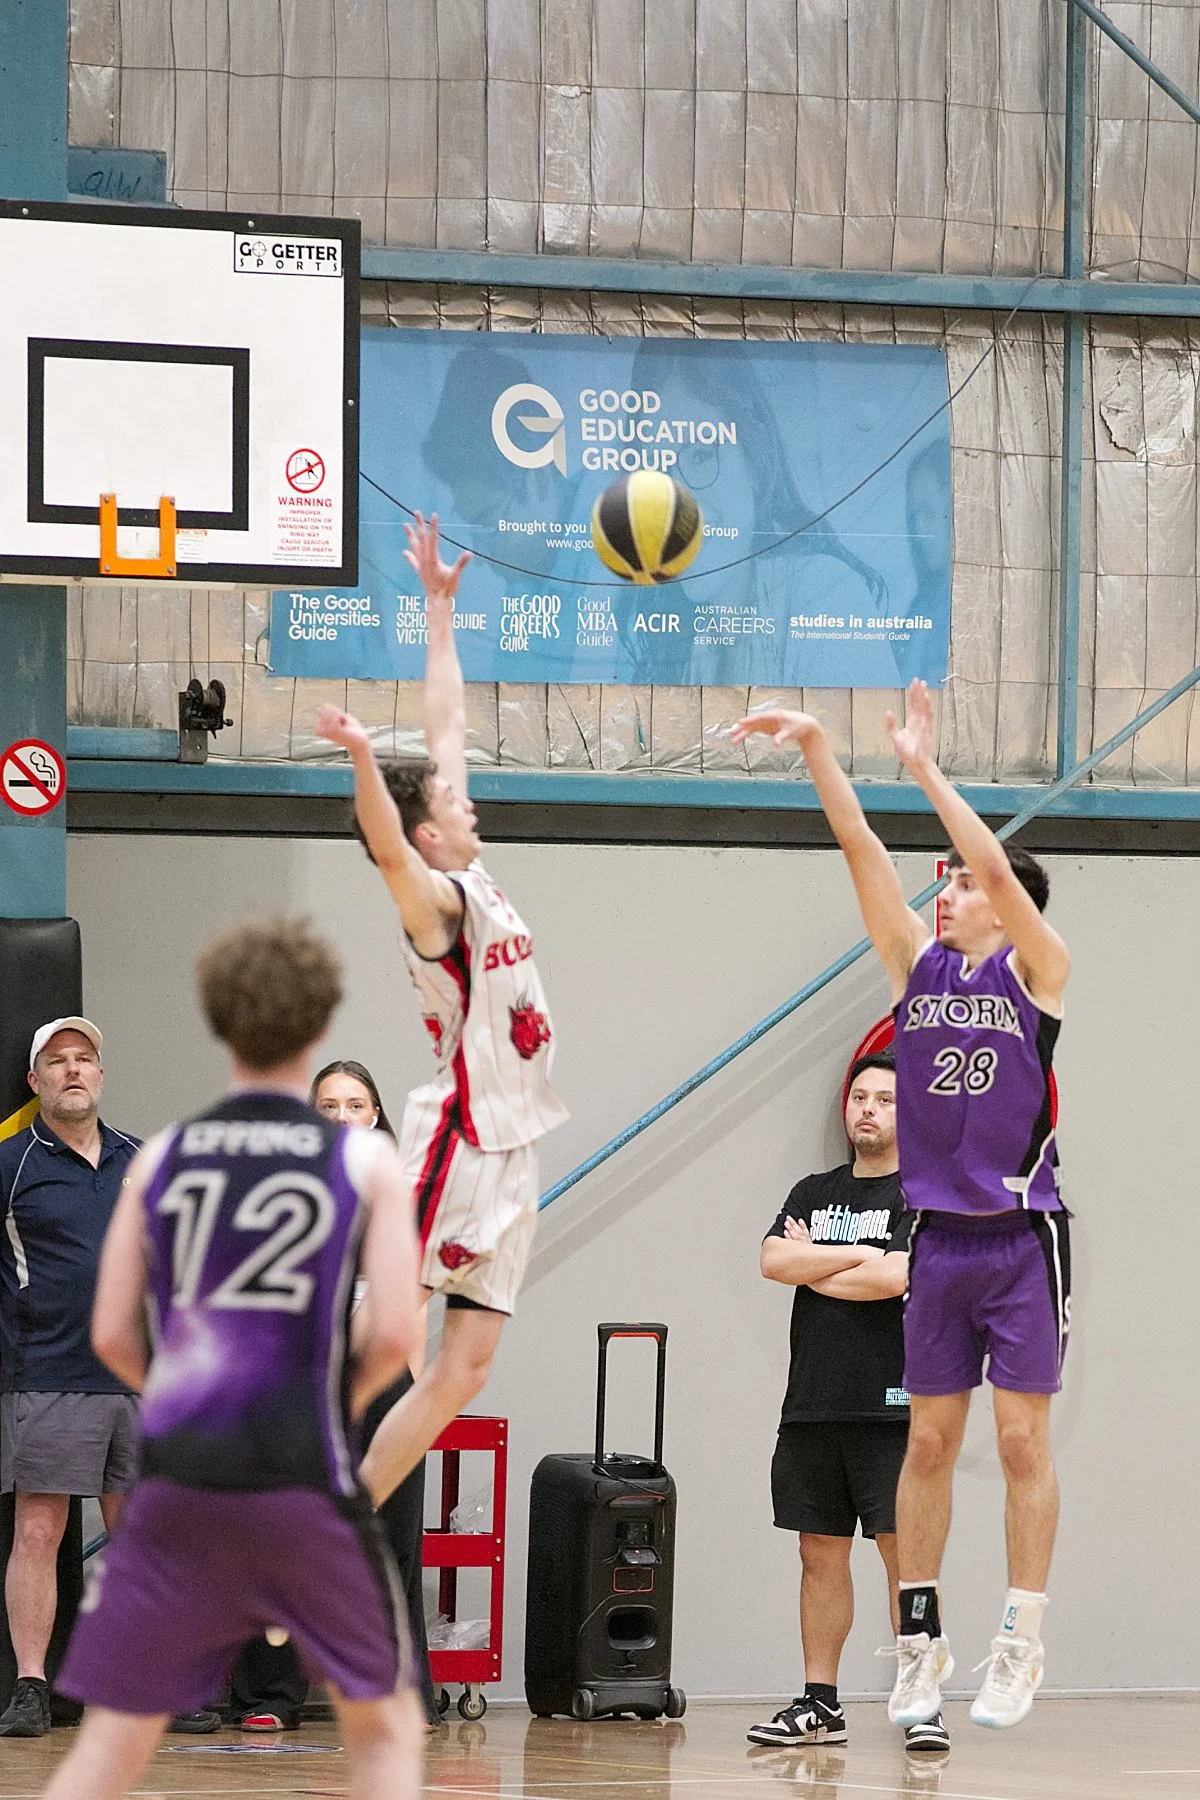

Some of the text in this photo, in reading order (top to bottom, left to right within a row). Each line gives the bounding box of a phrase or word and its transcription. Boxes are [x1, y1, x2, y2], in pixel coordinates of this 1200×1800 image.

[272, 243, 337, 260] GETTER
[240, 258, 336, 271] SPORTS
[579, 389, 661, 414] GOOD
[581, 418, 737, 445] EDUCATION
[582, 447, 678, 472] GROUP
[278, 496, 332, 507] WARNING
[498, 519, 547, 535] Brought
[549, 521, 562, 533] to
[564, 523, 587, 537] you
[703, 524, 739, 540] Group
[546, 538, 594, 552] www.goo
[289, 594, 371, 611] The Good
[396, 595, 421, 612] THE
[501, 594, 561, 615] THE GOOD
[577, 596, 611, 612] Good
[694, 605, 758, 615] AUSTRALIAN
[289, 610, 381, 627] Universities
[396, 612, 487, 630] SCHO GUIDE
[500, 613, 560, 638] CAREERS
[577, 612, 618, 631] MBA
[633, 613, 681, 633] ACIR
[693, 616, 776, 634] CAREERS
[790, 614, 933, 629] studies in australia
[288, 625, 338, 640] Guide
[576, 631, 613, 647] Guide
[693, 636, 735, 645] SERVICE
[790, 630, 911, 641] The International Students' Guide
[500, 635, 529, 652] GUIDE
[904, 992, 1024, 1040] STORM
[927, 1046, 998, 1096] 28
[157, 1168, 337, 1315] 12
